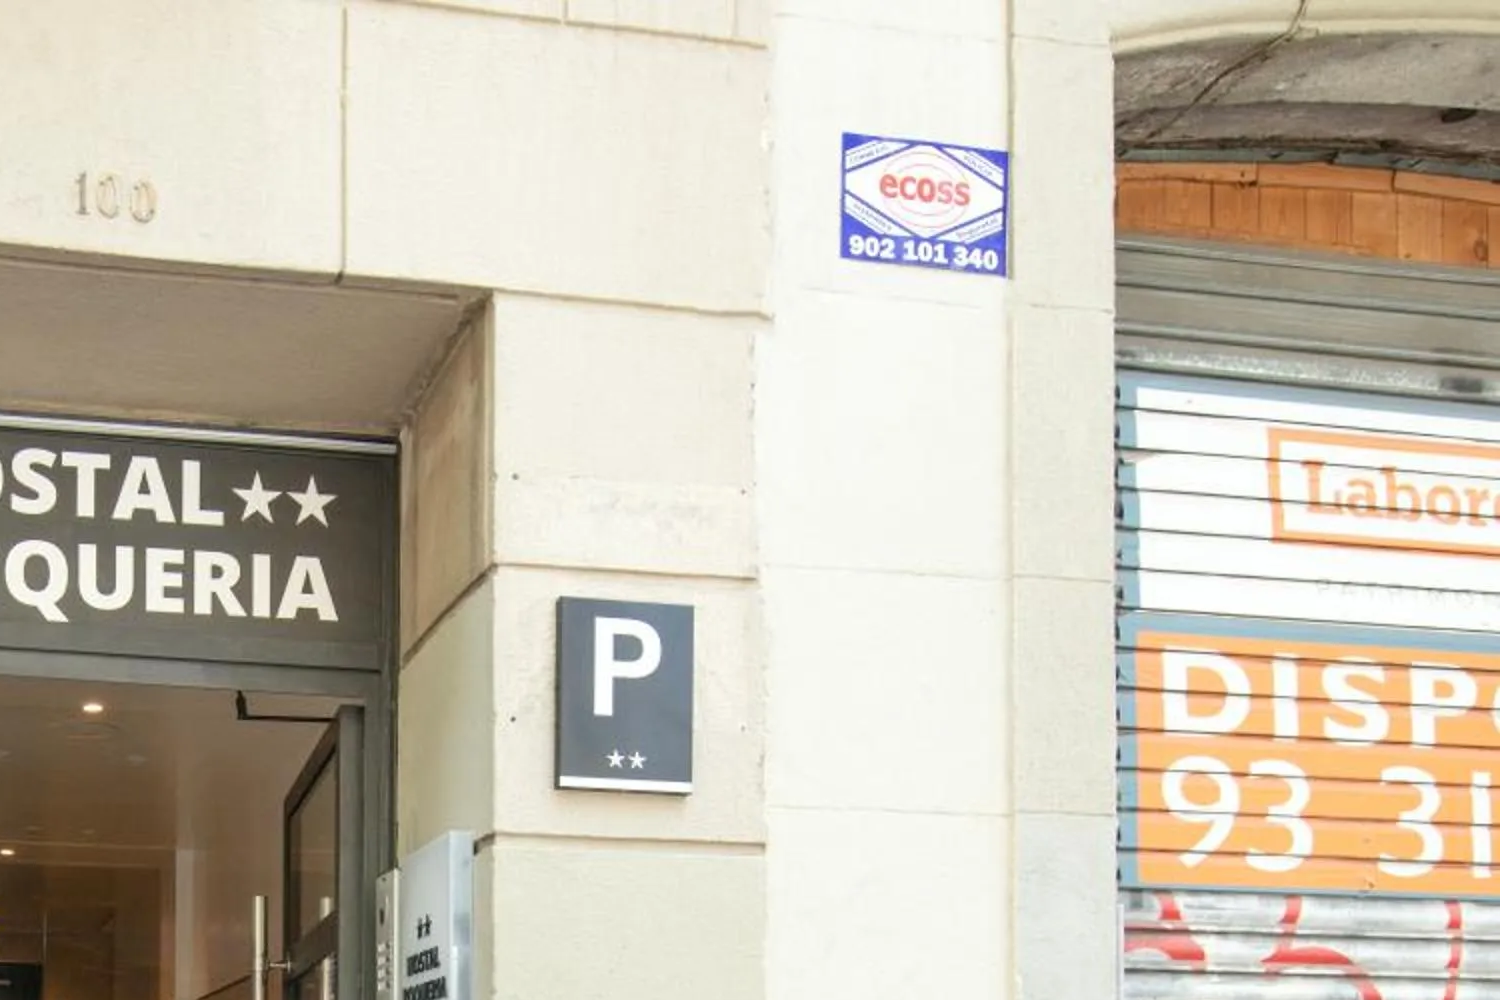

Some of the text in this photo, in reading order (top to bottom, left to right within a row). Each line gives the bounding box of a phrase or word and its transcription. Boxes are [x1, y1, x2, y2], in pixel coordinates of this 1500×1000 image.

[74, 170, 158, 224] 100
[879, 174, 971, 206] ecoss
[848, 235, 999, 270] 902 101 340
[593, 616, 662, 716] P
[1161, 645, 1500, 749] DISP
[1161, 755, 1314, 872] 93
